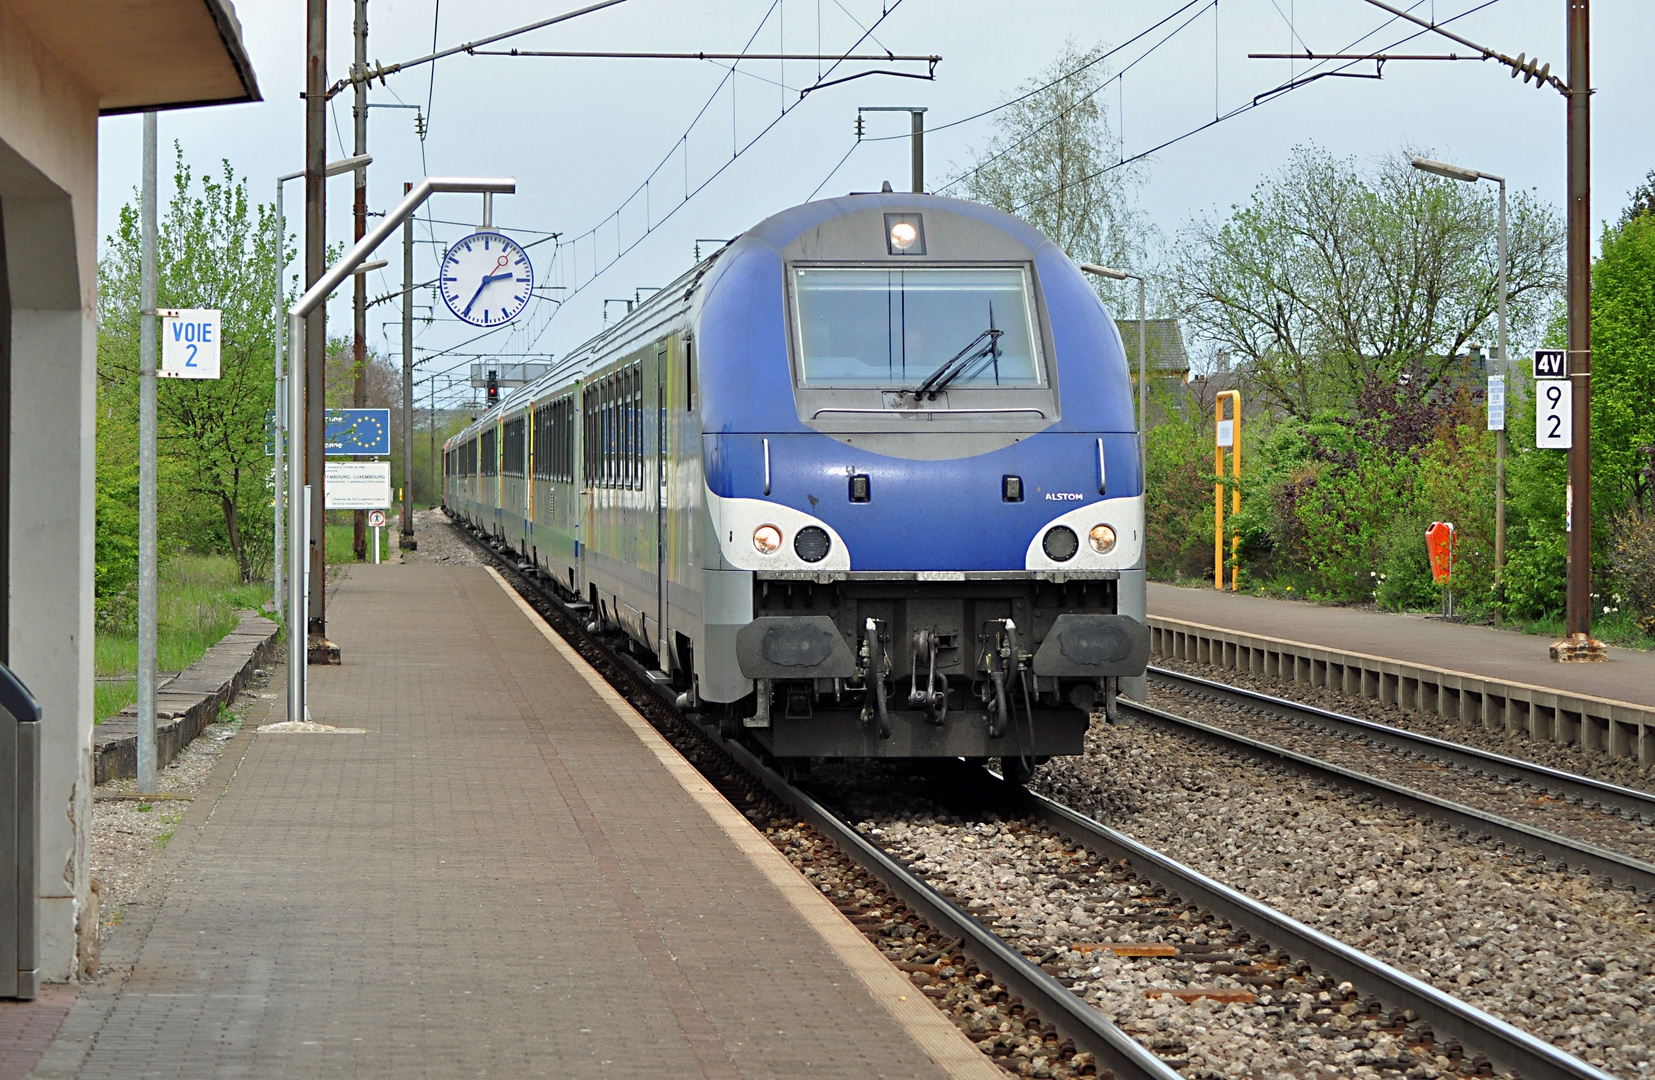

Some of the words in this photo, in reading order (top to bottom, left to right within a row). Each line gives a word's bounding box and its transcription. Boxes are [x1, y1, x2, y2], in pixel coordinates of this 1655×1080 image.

[172, 322, 212, 342] VOIE
[185, 343, 198, 367] 2
[1538, 354, 1562, 373] 4V
[1546, 386, 1562, 410] 9
[1547, 414, 1561, 438] 2
[1045, 492, 1084, 501] ALSTOM
